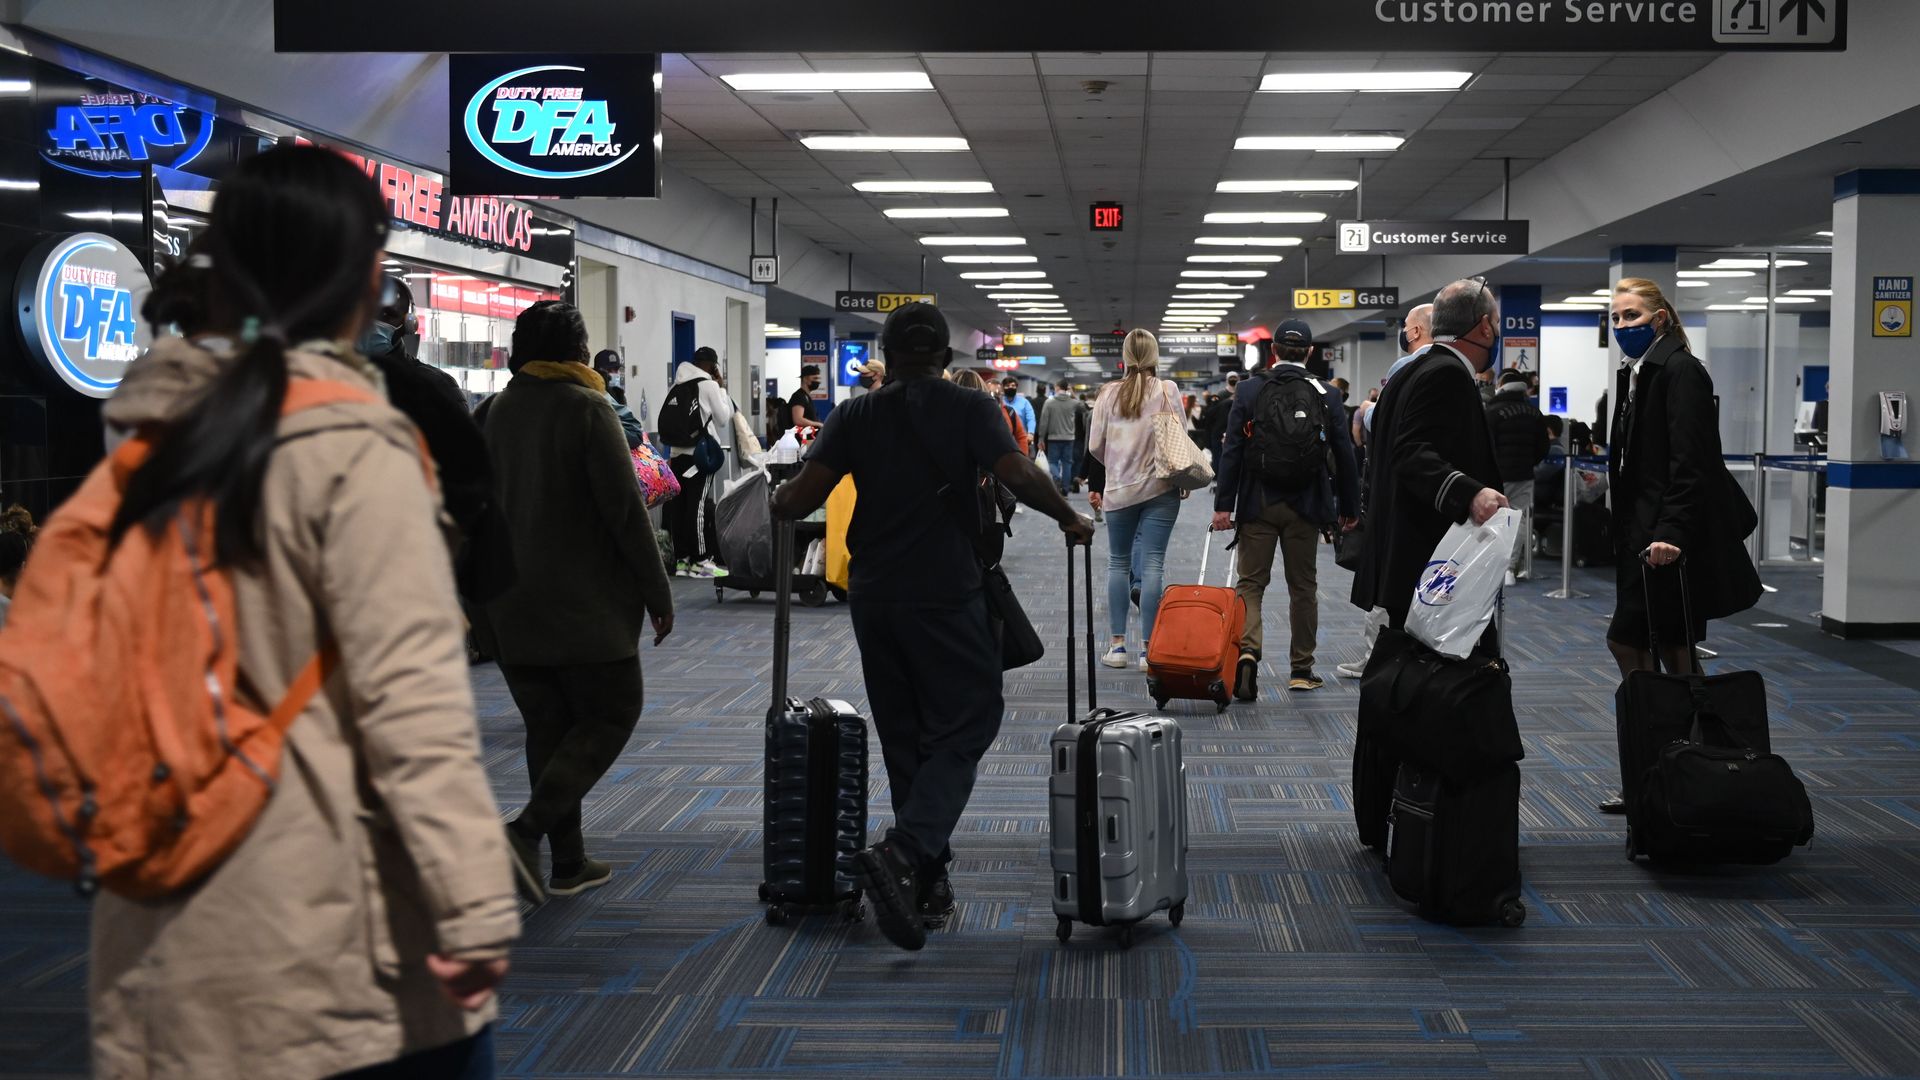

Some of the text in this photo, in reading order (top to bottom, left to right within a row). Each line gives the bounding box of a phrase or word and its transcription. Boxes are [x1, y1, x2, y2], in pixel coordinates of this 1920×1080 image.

[1375, 0, 1551, 24] Customer
[1565, 0, 1697, 24] Service
[496, 87, 584, 100] DUTY FREE
[491, 99, 617, 156] DFA
[549, 143, 622, 156] AMERICAS
[379, 162, 534, 251] FREE AMERICAS
[1095, 208, 1119, 227] EXIT
[1372, 231, 1447, 244] Customer
[1451, 231, 1507, 244] Service
[62, 264, 118, 288] DUTY FREE
[1878, 279, 1908, 290] HAND
[1297, 292, 1395, 306] D15 Gate
[1875, 291, 1912, 299] SANITIZER
[840, 296, 875, 308] Gate
[60, 281, 137, 360] DFA
[1505, 317, 1535, 330] D15
[804, 341, 826, 351] D18
